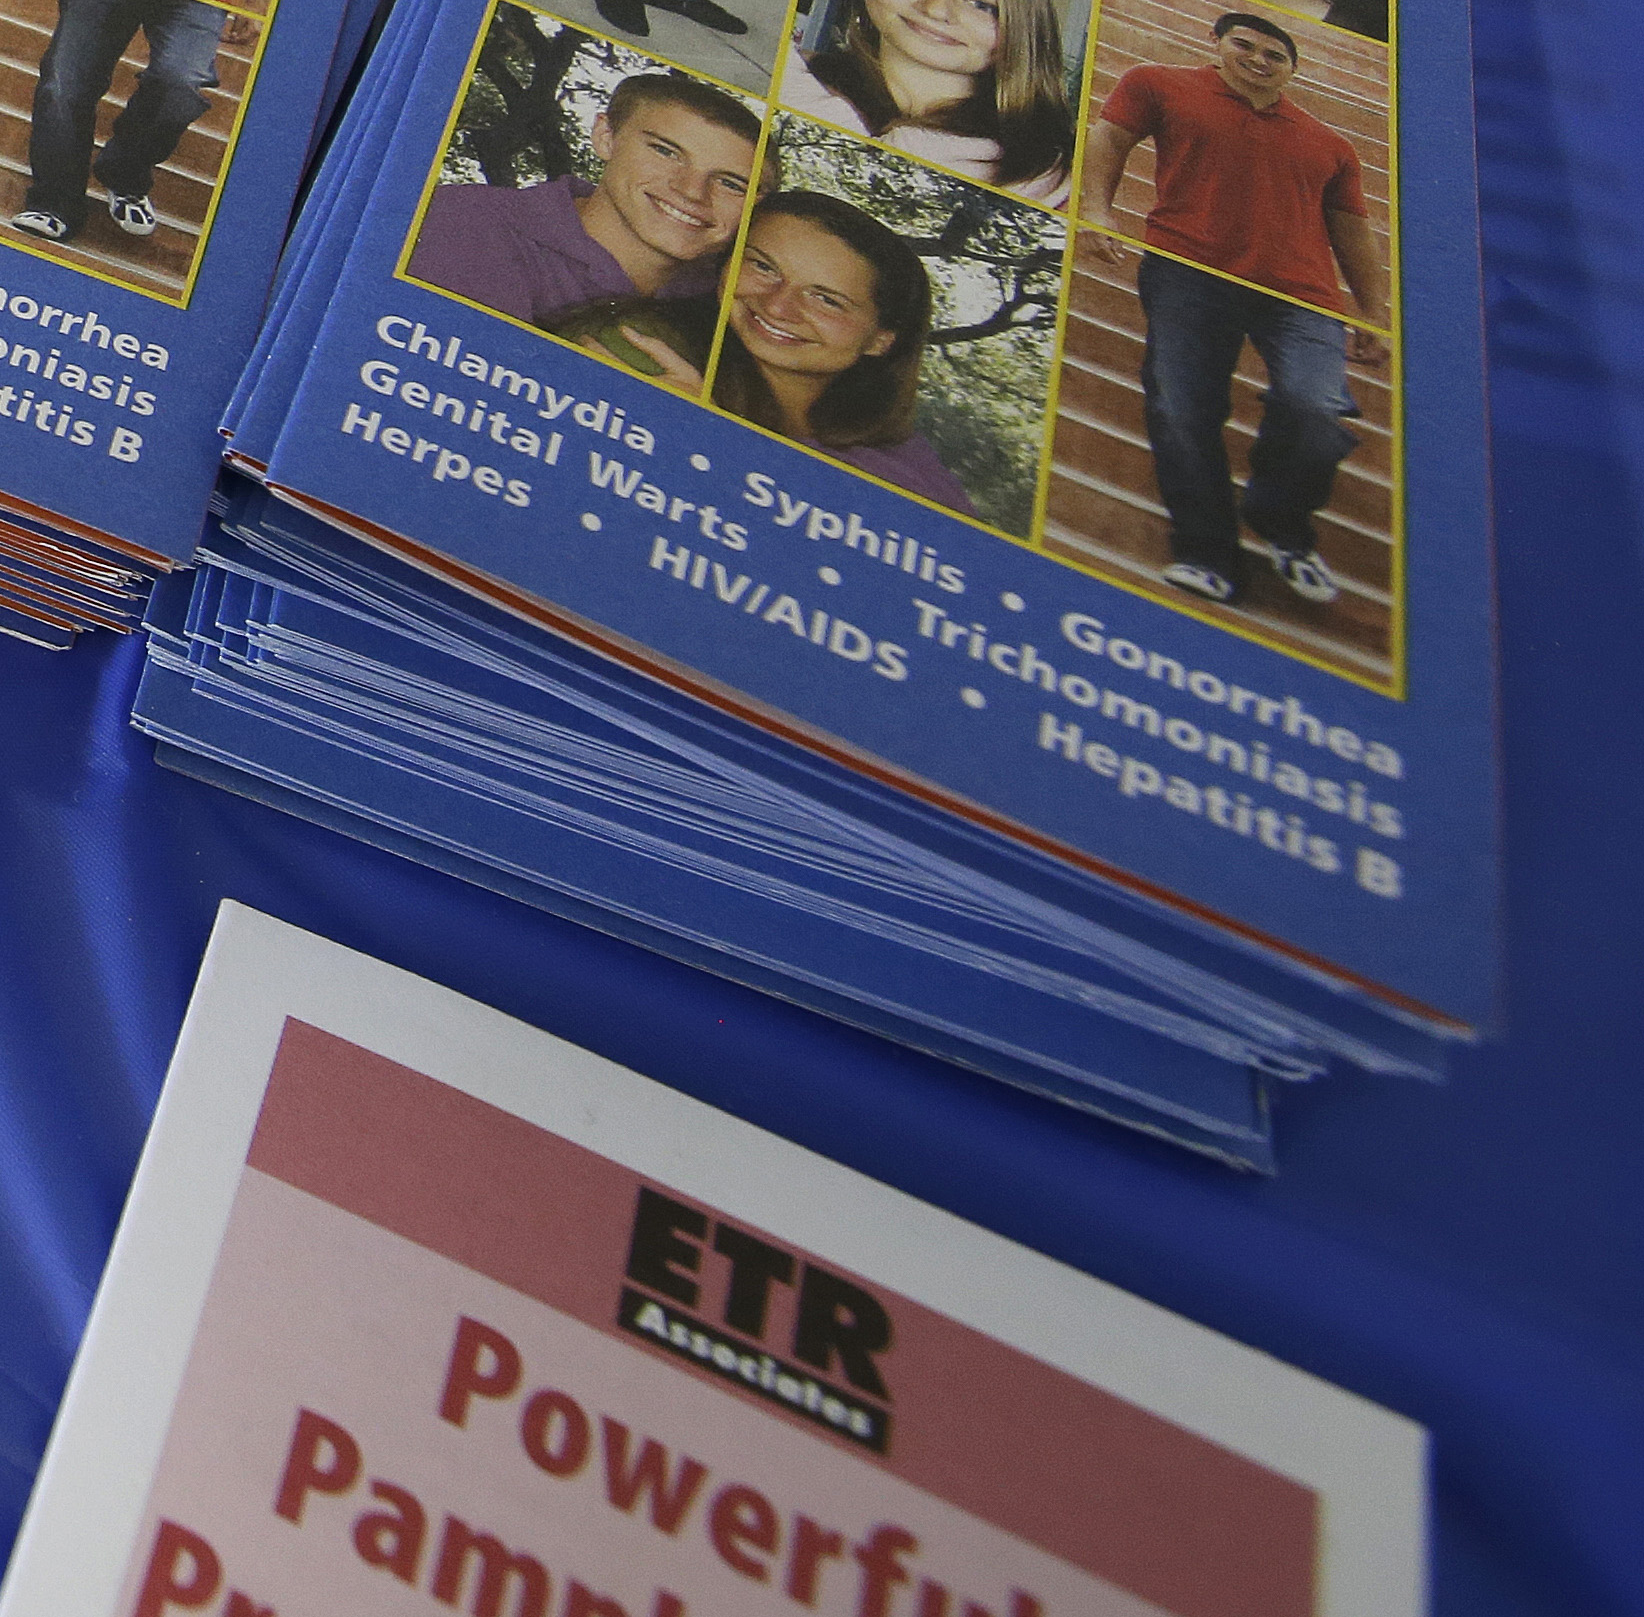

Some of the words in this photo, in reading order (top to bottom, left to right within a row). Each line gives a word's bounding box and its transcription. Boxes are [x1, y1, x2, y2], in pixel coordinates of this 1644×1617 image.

[109, 428, 146, 464] B
[359, 359, 563, 467] Genital
[586, 450, 751, 553] Warts
[913, 600, 1406, 841] Trichomoniasis
[376, 314, 657, 457] Chlamydia
[744, 471, 967, 595] Syphilis
[1060, 612, 1406, 779] Gonorrhea
[341, 402, 533, 509] Herpes
[650, 534, 910, 683] HIV/AIDS
[1037, 714, 1342, 873] Hepatitis
[1359, 857, 1404, 899] B
[626, 1185, 894, 1403] ETR
[633, 1301, 874, 1438] Associates
